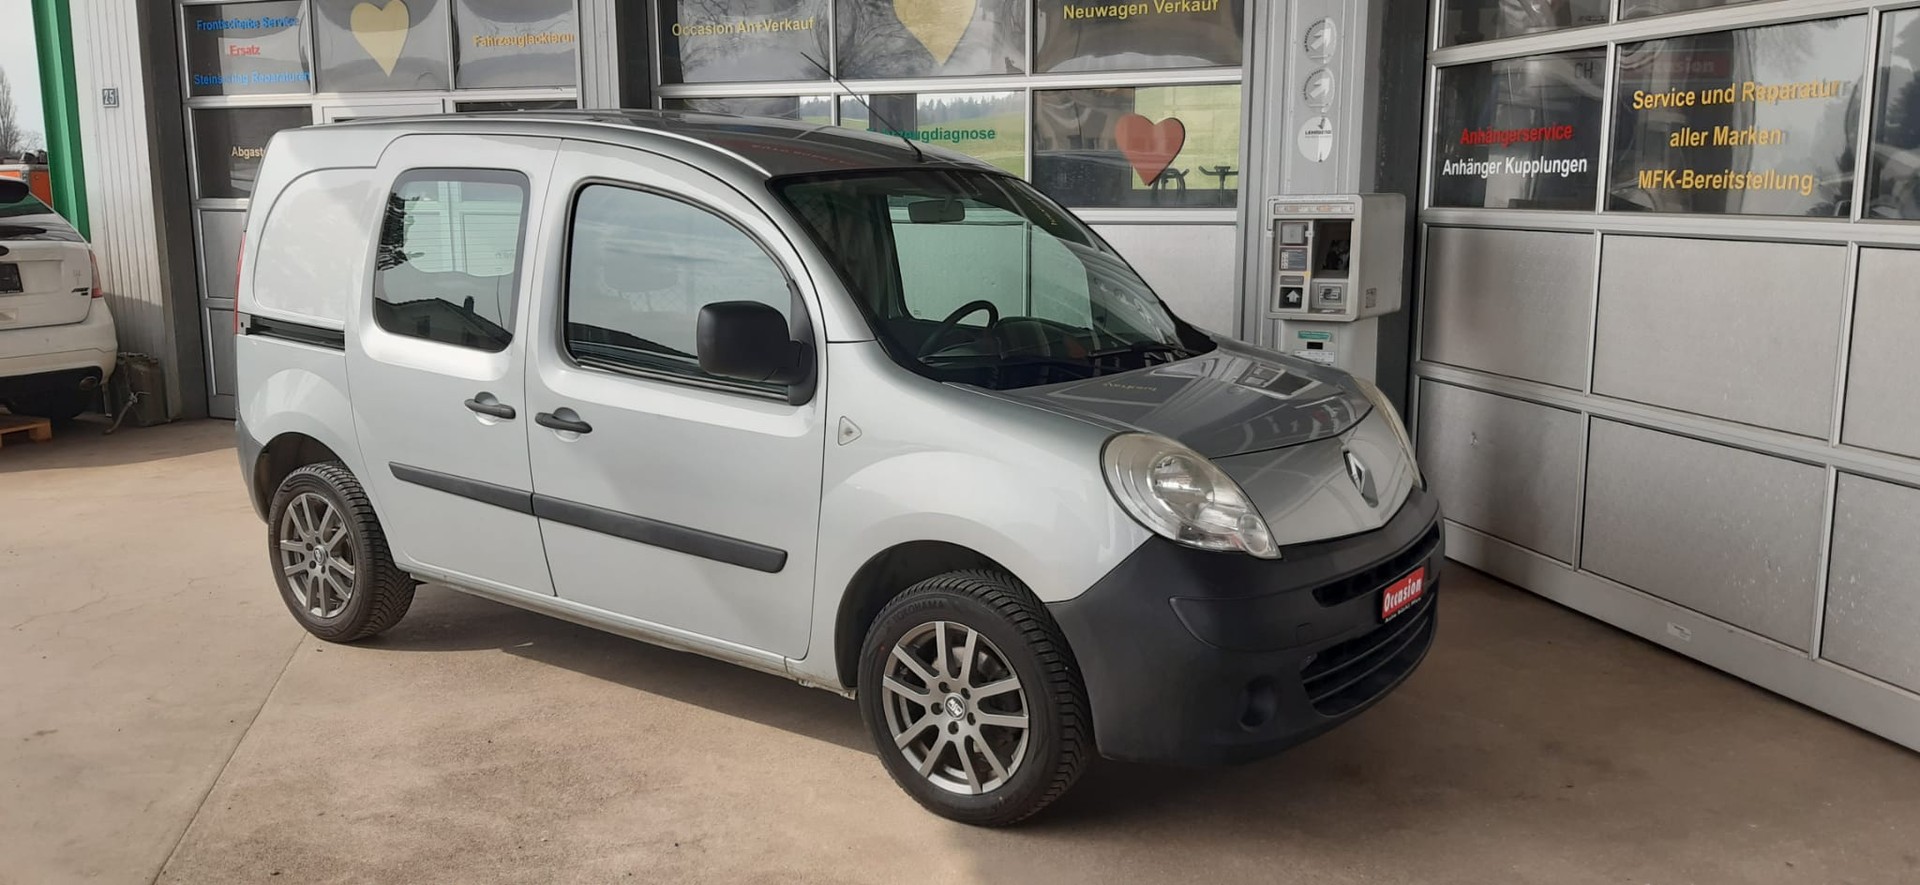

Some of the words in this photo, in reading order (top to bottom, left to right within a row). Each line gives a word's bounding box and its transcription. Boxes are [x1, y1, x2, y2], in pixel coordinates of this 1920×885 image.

[1063, 3, 1148, 19] Neuwagen
[1154, 0, 1219, 13] Verkauf
[262, 16, 299, 28] Service
[671, 23, 733, 36] Occasion
[229, 44, 261, 56] Ersatz
[104, 89, 115, 105] 25
[1632, 87, 1696, 110] Service
[1701, 83, 1736, 105] und
[1741, 80, 1841, 105] Reparatur
[1460, 123, 1573, 149] Anhängerservice
[1669, 127, 1708, 148] aller
[1713, 125, 1783, 147] Marken
[1442, 158, 1502, 179] Anhänger
[1505, 155, 1588, 178] Kupplungen
[1637, 168, 1814, 196] MFK-Bereitstellung
[1384, 578, 1422, 612] Occasion
